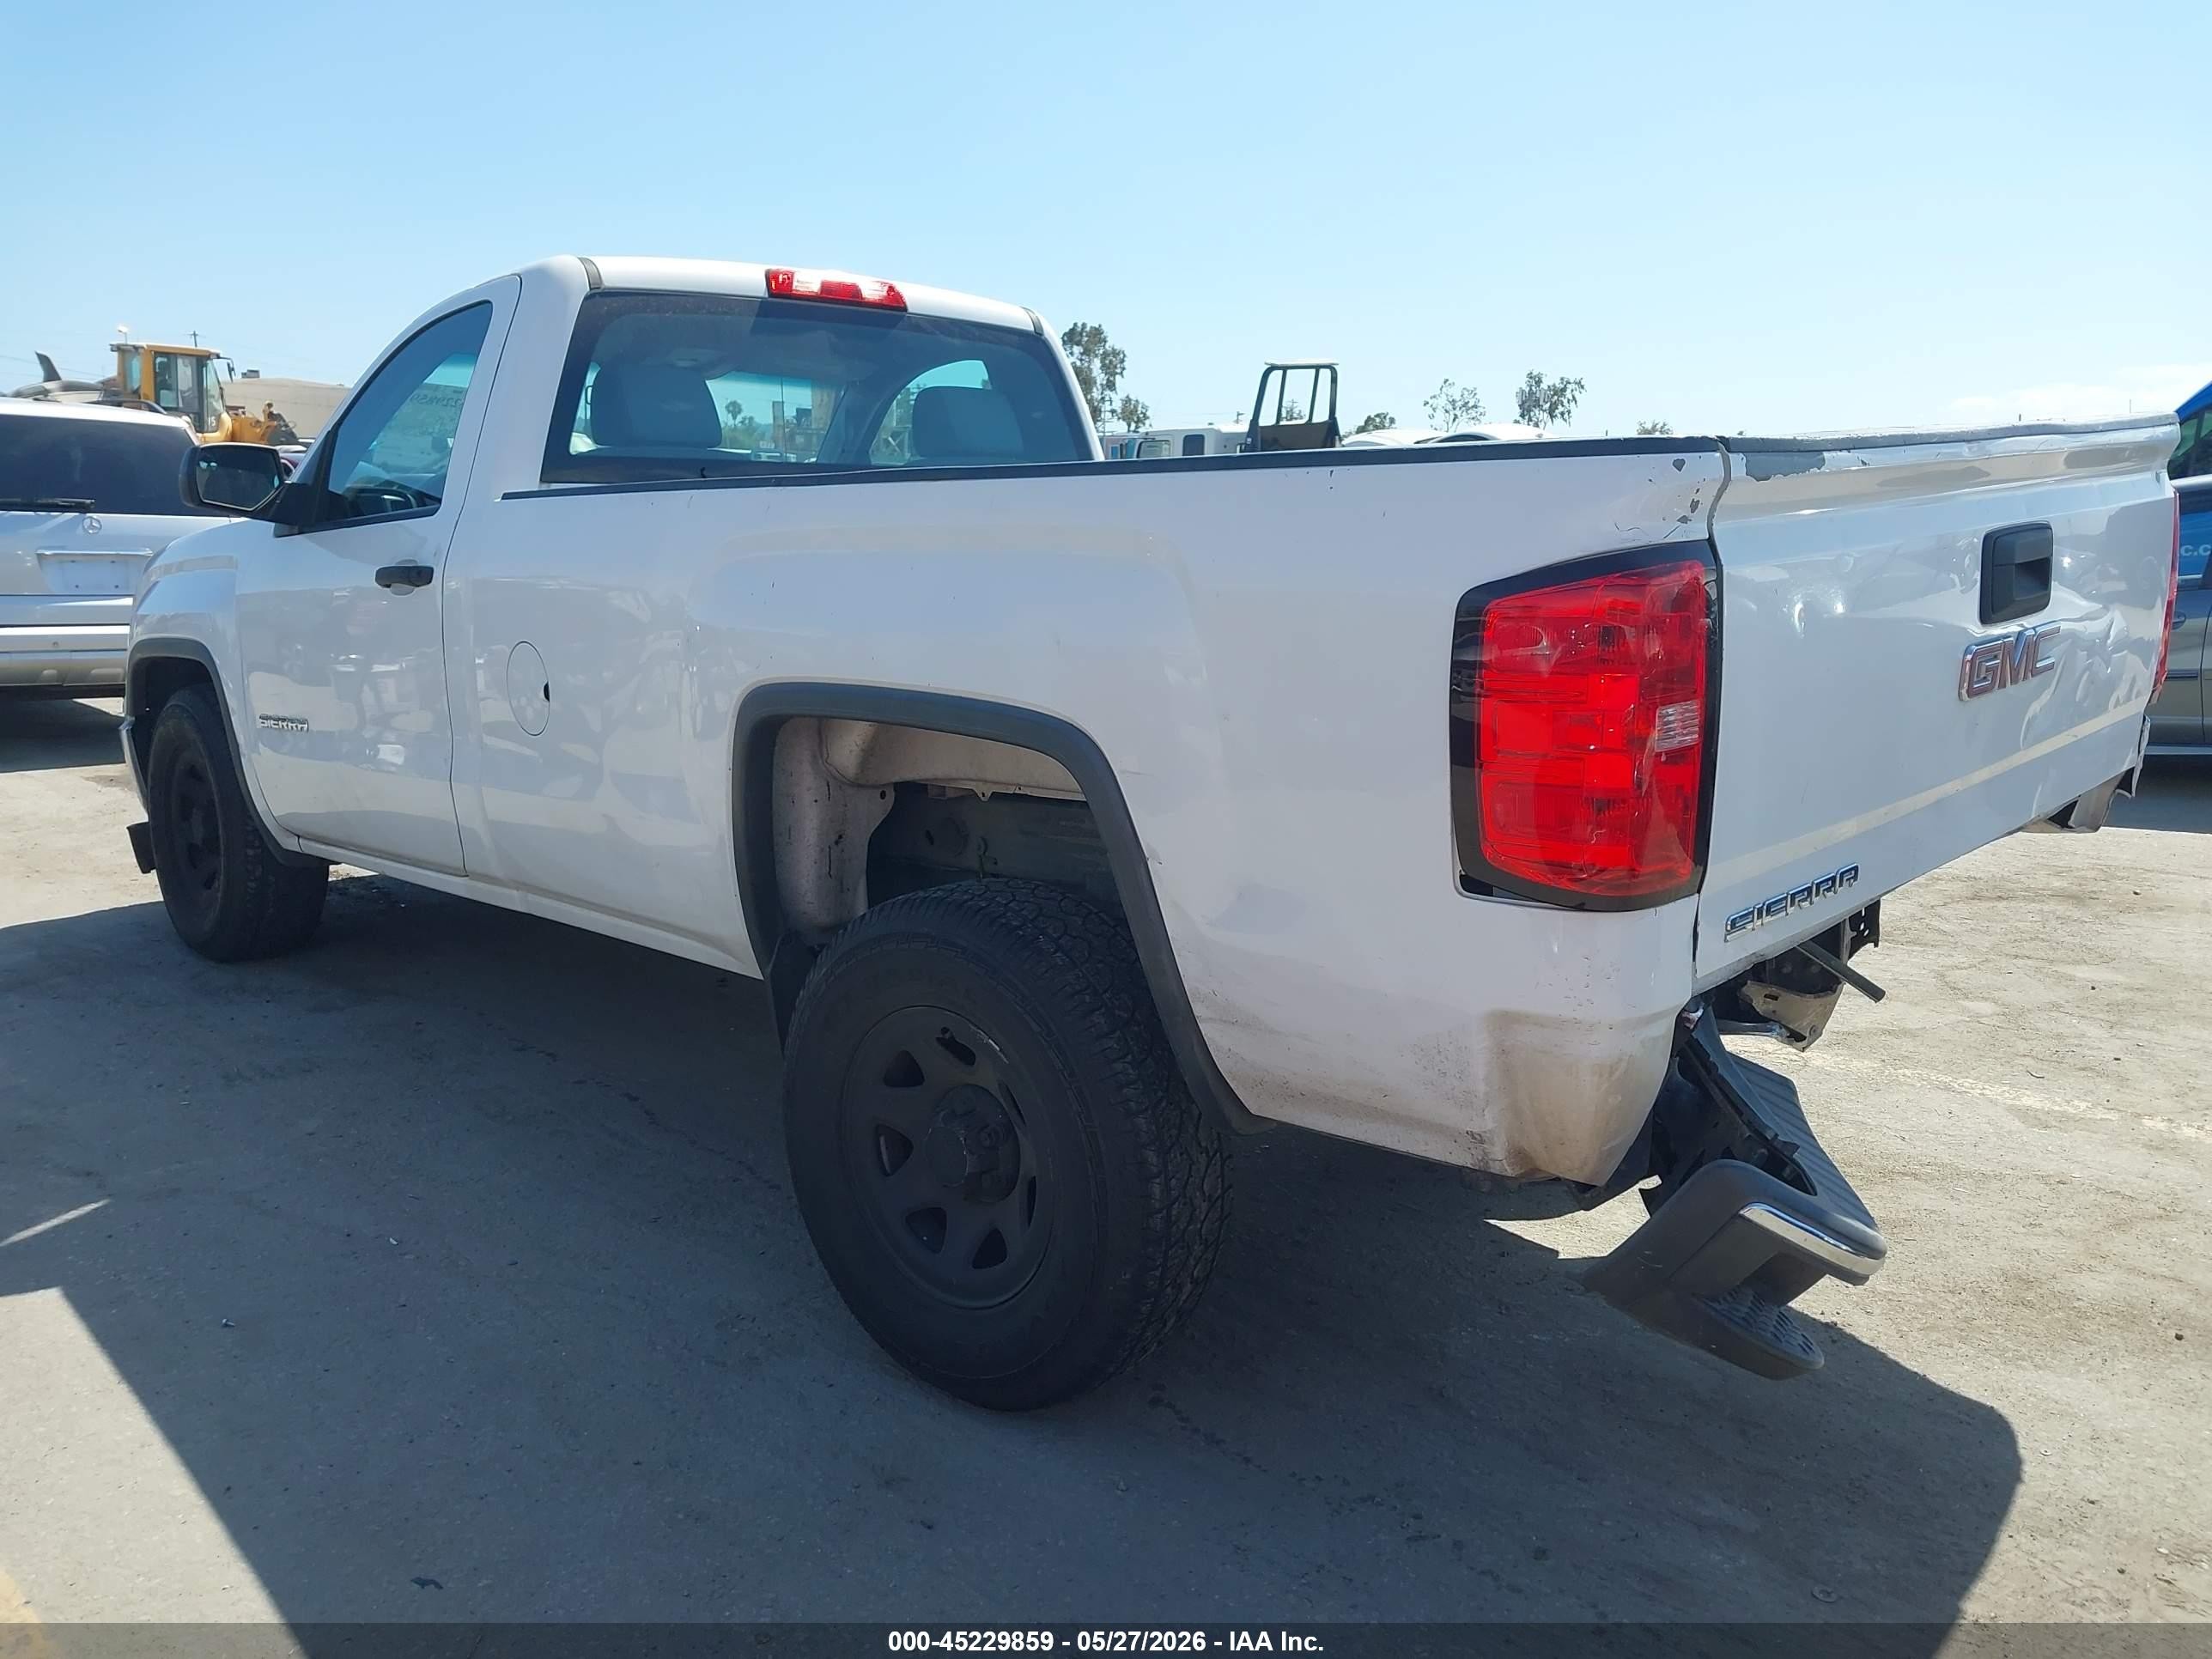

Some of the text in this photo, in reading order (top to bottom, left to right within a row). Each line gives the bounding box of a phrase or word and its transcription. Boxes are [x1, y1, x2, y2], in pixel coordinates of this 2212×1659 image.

[1958, 620, 2062, 701] GMC
[257, 713, 309, 732] SIERRA
[1724, 863, 1860, 943] SIERRA
